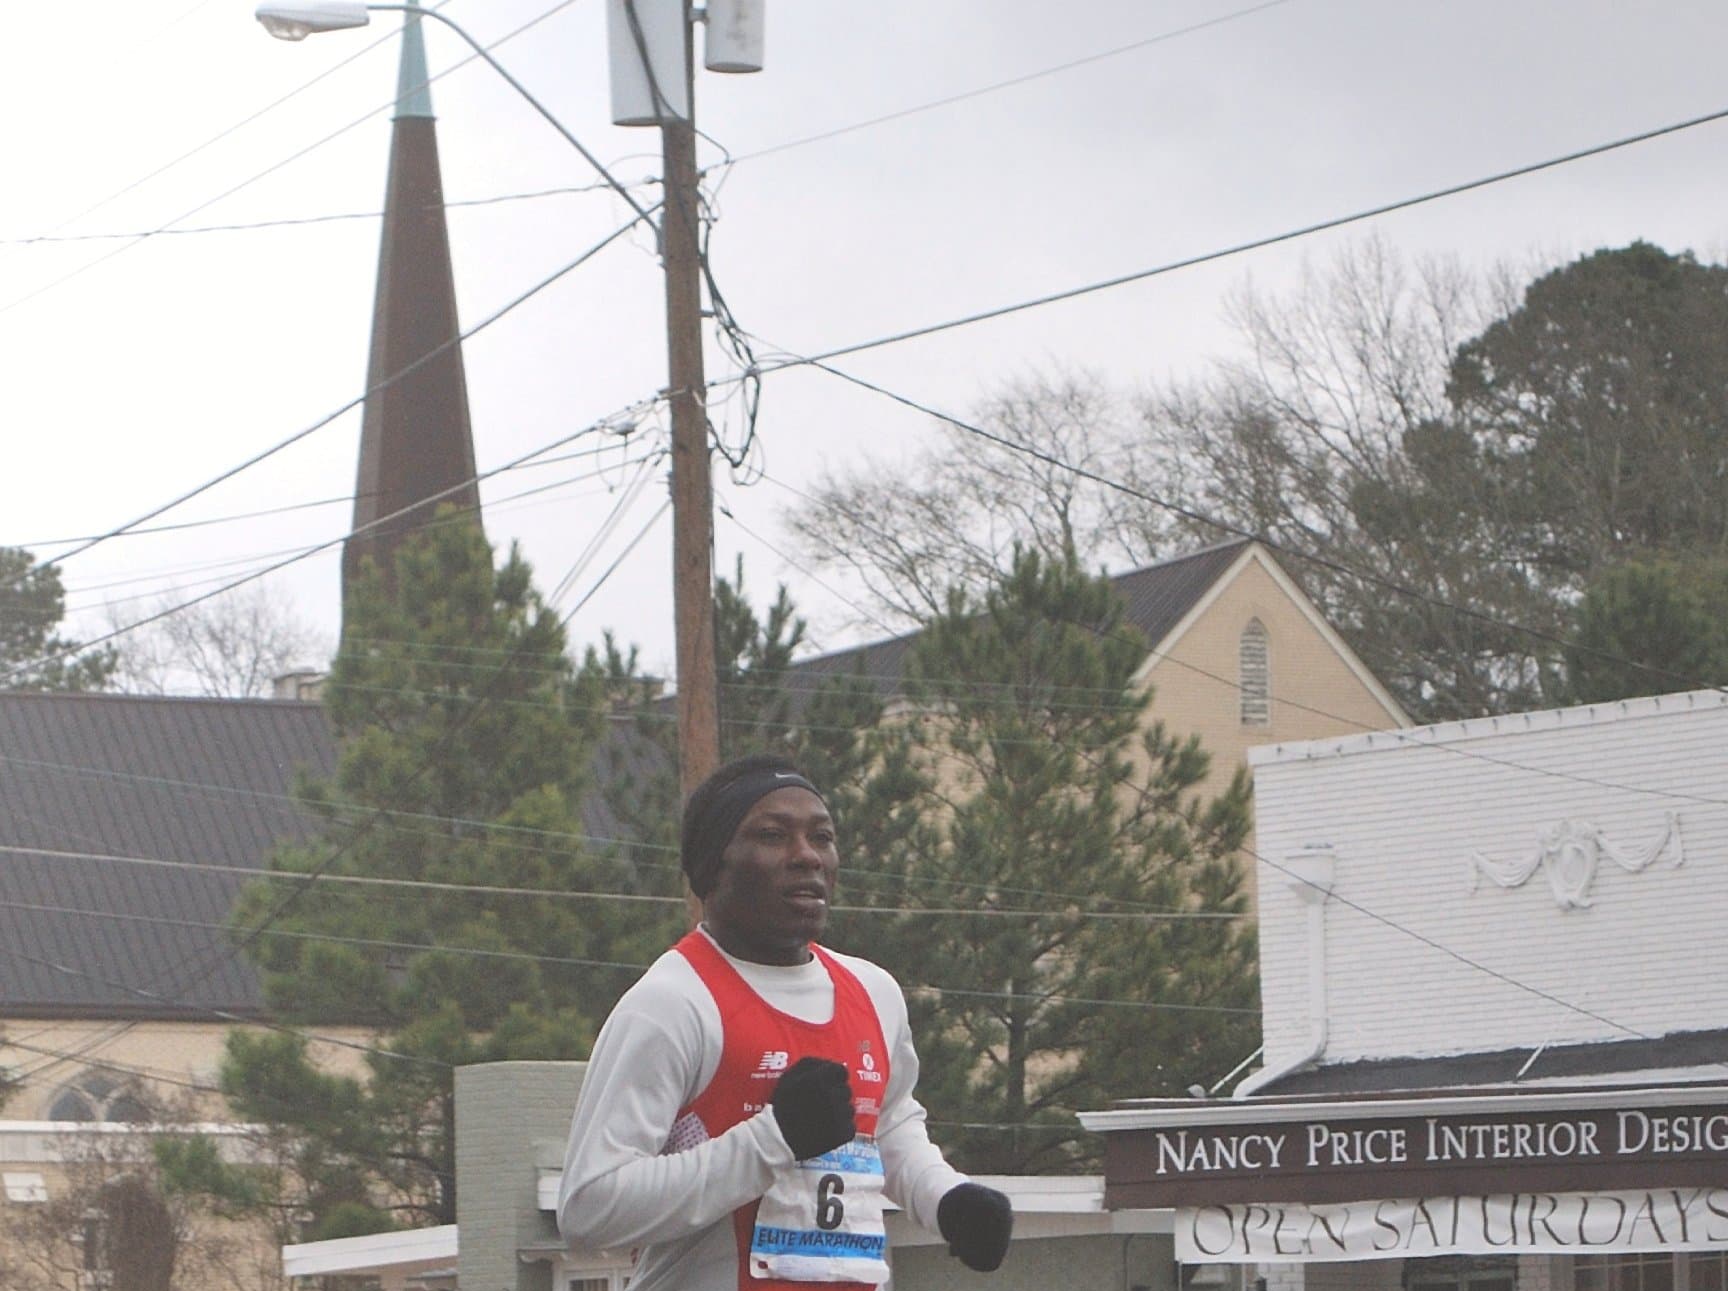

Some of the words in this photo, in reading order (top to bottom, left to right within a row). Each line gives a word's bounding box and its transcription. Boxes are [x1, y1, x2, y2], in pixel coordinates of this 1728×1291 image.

[1155, 1131, 1287, 1175] NANCY
[1305, 1124, 1408, 1167] PRICE
[1425, 1118, 1601, 1161] INTERIOR
[816, 1173, 845, 1231] 6
[1192, 1203, 1350, 1256] OPEN
[1371, 1188, 1728, 1251] SATURDAYS
[757, 1228, 798, 1247] ELITE
[798, 1231, 885, 1250] MARATHON
